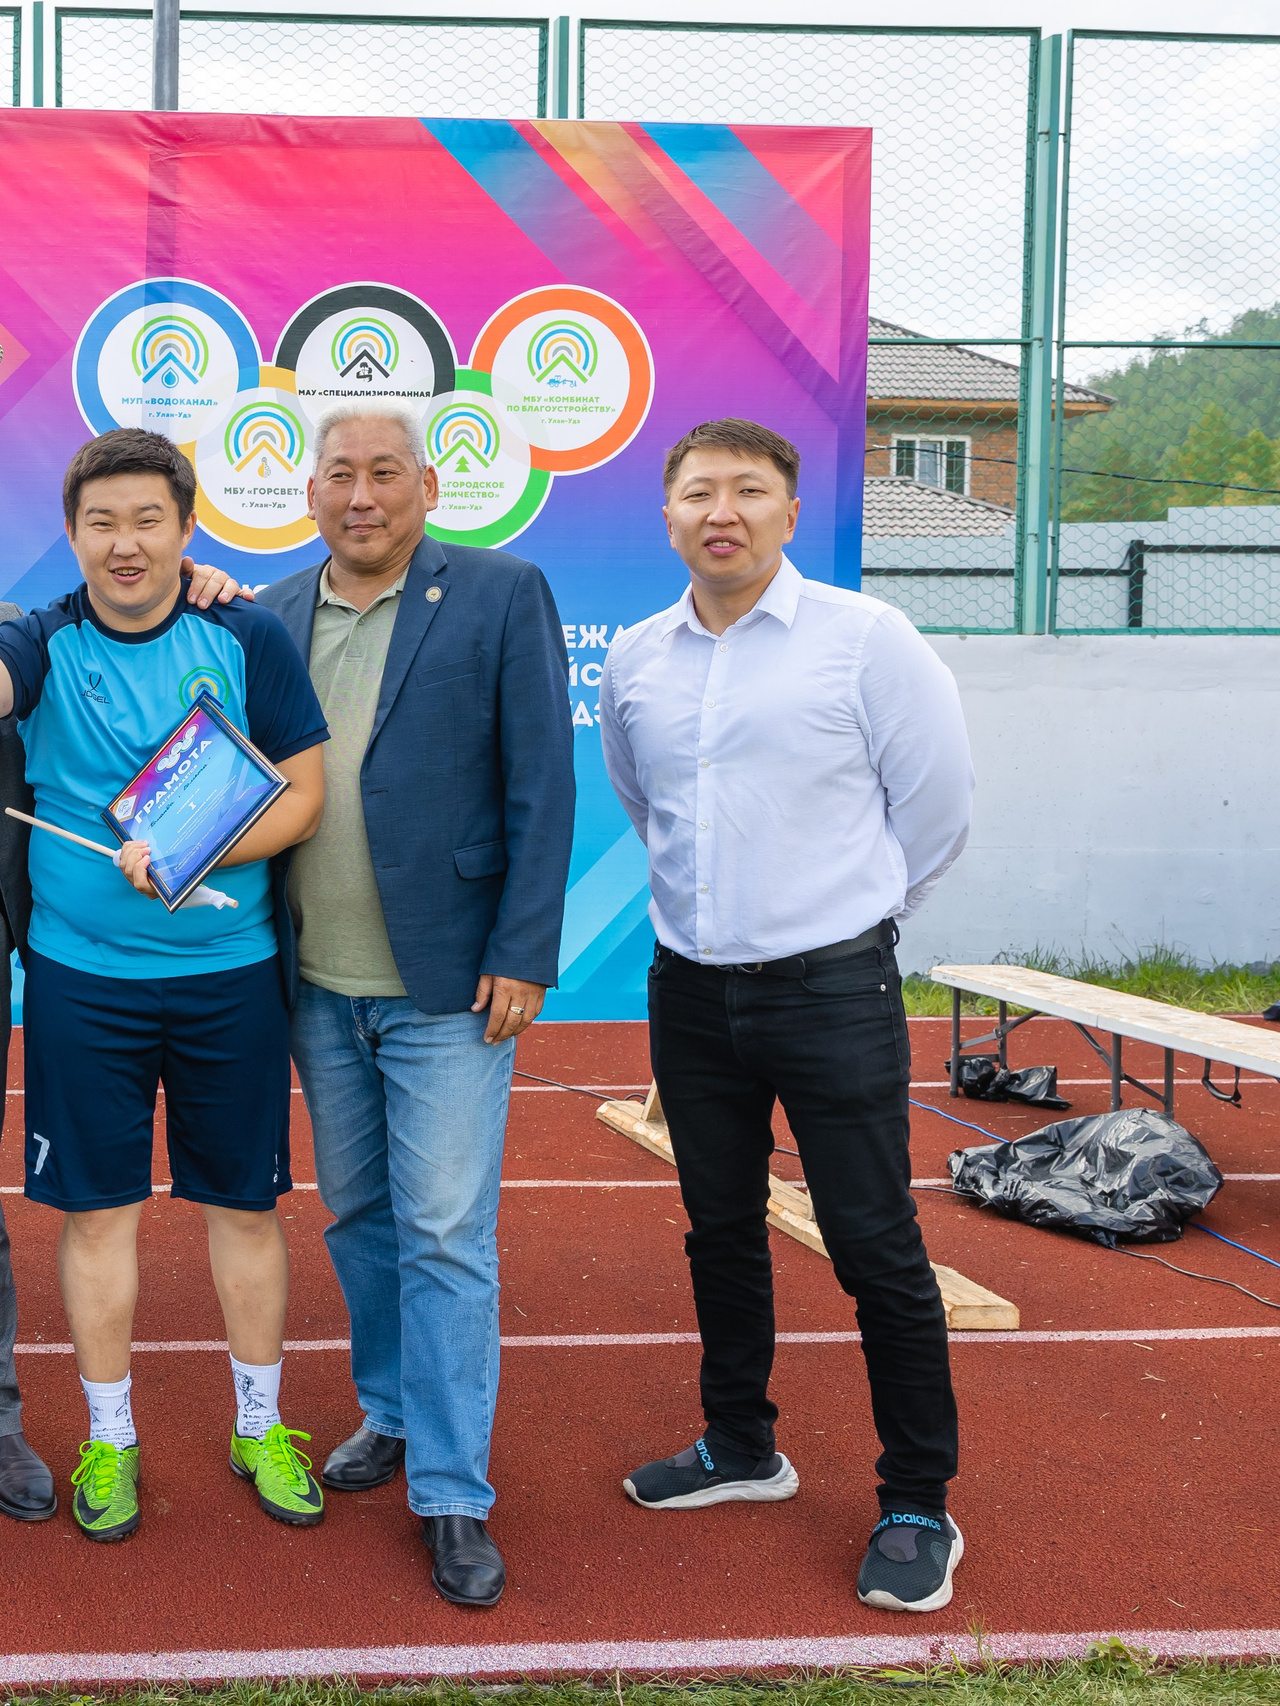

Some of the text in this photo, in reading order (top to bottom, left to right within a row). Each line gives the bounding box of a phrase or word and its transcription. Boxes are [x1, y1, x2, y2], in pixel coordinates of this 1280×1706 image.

[318, 389, 431, 398] «СПЕЦИАЛИЗИРОВАННАЯ
[121, 397, 218, 407] МУП «ВОДОКАНАЛ»
[521, 404, 616, 413] БЛАГОУСТРОЙСТВУ»
[442, 481, 505, 489] «ГОРОДСКОЕ
[224, 487, 305, 496] МБУ «ГОРСВЕТ»
[249, 501, 287, 509] Улан-Удэ
[134, 741, 213, 824] ГРАМОТА
[33, 1132, 50, 1175] 7
[872, 1512, 942, 1533] ew balance
